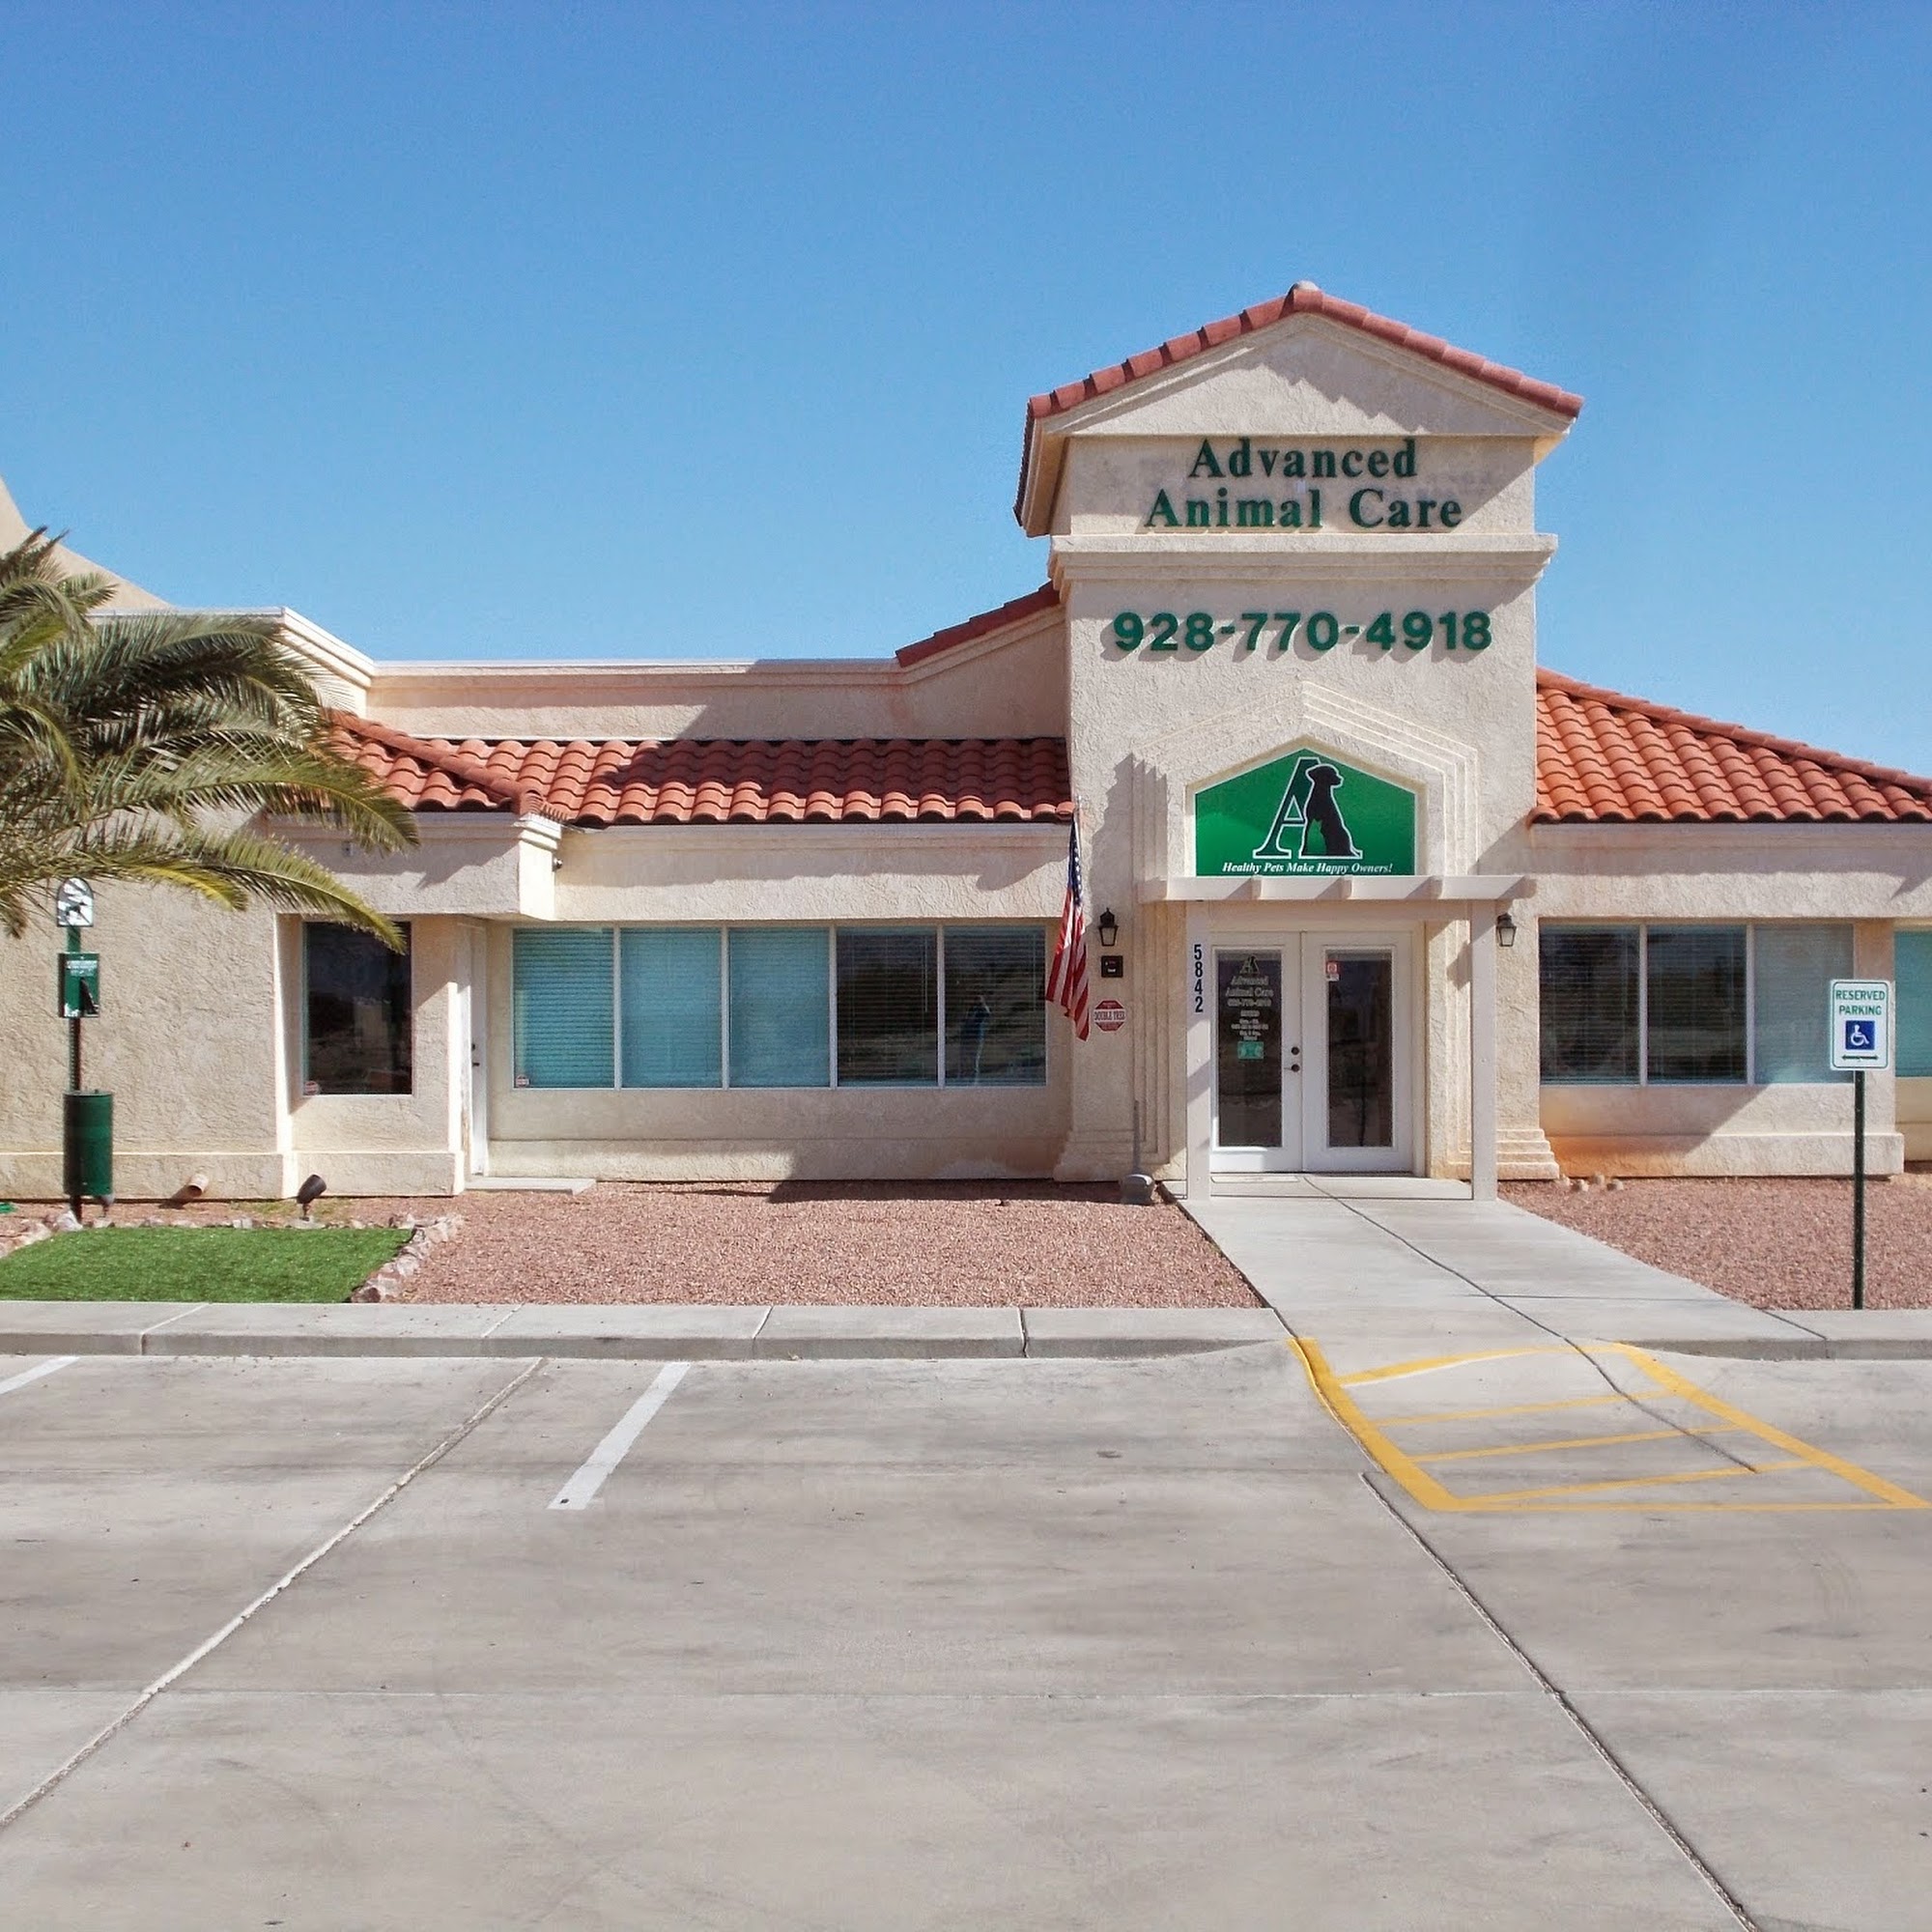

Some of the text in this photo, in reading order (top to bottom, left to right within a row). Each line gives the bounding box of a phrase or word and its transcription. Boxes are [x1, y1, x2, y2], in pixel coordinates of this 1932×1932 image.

[1188, 437, 1418, 479] Advanced
[1143, 487, 1463, 529] Animal Care
[1113, 611, 1493, 652] 928-770-4918
[1222, 862, 1393, 875] Healthy Pets Make Happy Owners!
[1194, 944, 1204, 1013] 5842
[1835, 989, 1886, 1001] RESERVED
[1838, 1005, 1883, 1016] PARKING
